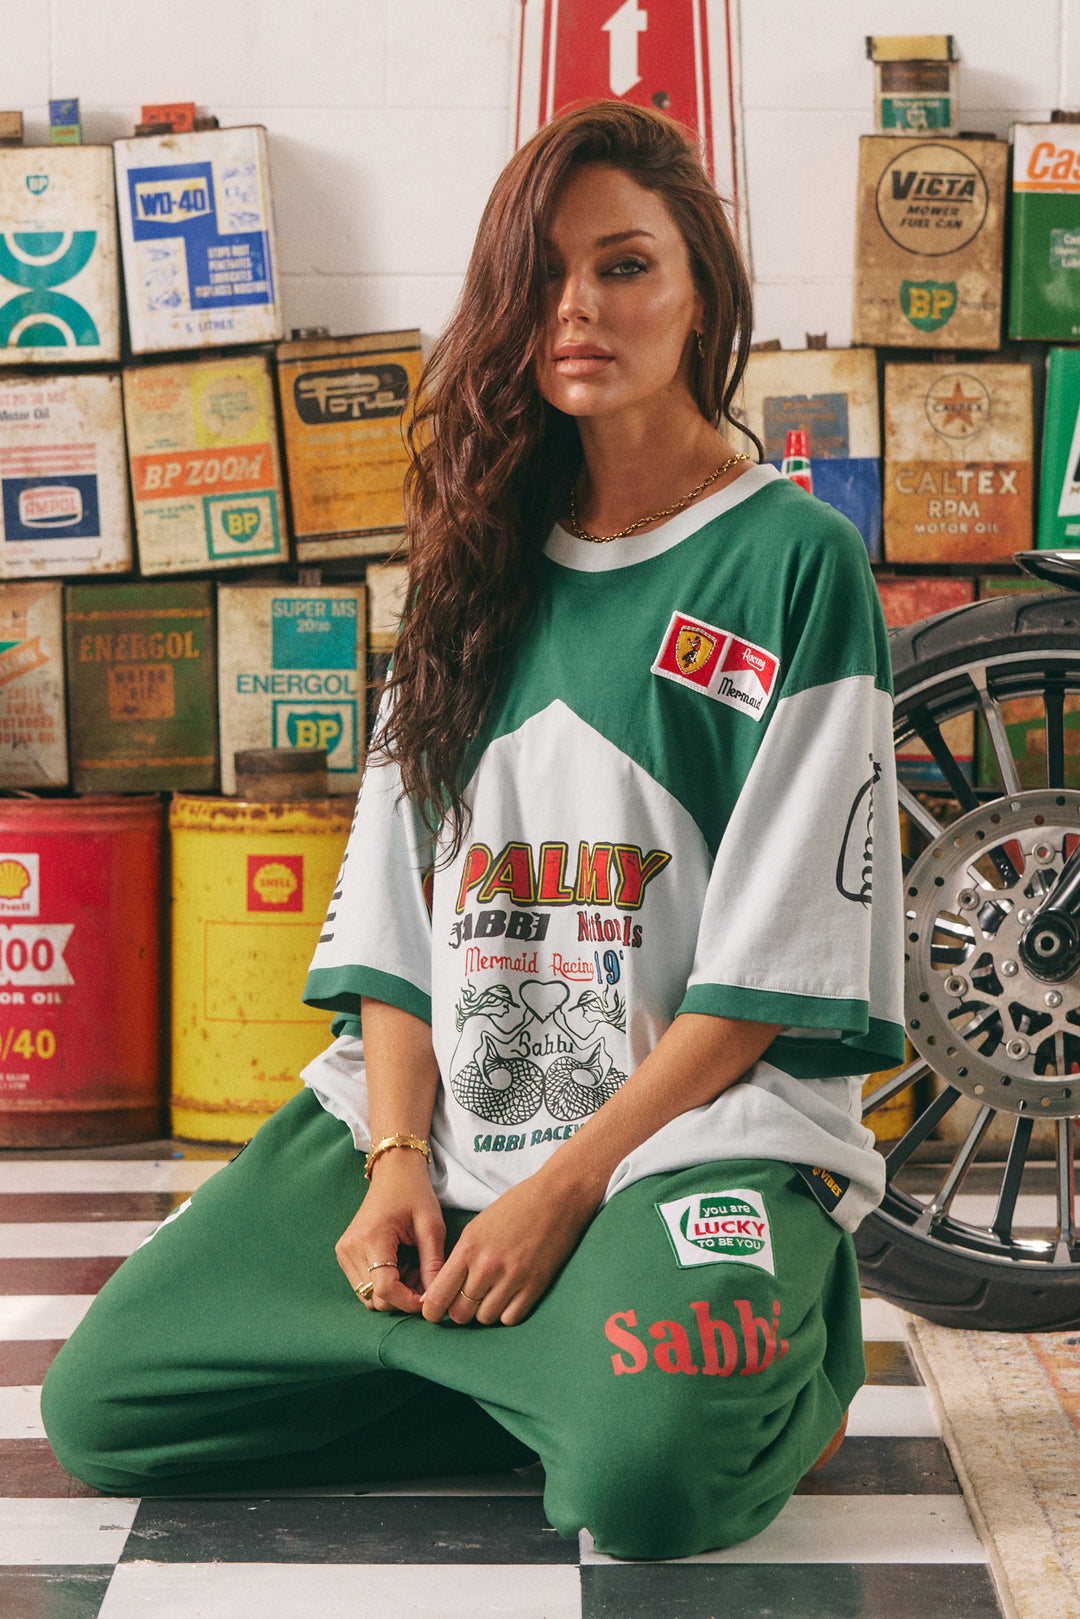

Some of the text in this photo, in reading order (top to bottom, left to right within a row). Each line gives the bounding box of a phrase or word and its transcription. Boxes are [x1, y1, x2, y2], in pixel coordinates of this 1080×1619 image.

[892, 170, 975, 199] VICTA
[140, 188, 206, 216] WD-40
[907, 205, 959, 216] MOWER
[935, 218, 963, 229] CAN
[908, 287, 954, 320] BP
[144, 454, 265, 490] BP ZOOM
[895, 469, 1019, 496] CALTEX
[929, 500, 980, 519] RPM
[227, 512, 258, 536] BP
[913, 522, 1000, 535] MOTOR OIL
[272, 601, 327, 618] SUPER
[79, 631, 200, 662] ENERGOL
[237, 674, 358, 695] ENERGOL
[717, 677, 763, 711] Mermaid
[295, 720, 340, 749] BP
[455, 840, 672, 915] PALMY
[0, 938, 54, 972] 00
[465, 946, 594, 981] Mermaid Racing
[31, 991, 63, 1005] OIL
[473, 1133, 527, 1153] SABBI
[820, 1168, 843, 1198] VIBES
[702, 1204, 751, 1218] you are
[694, 1220, 765, 1238] LUCKY
[697, 1237, 761, 1250] TO BE YOU
[604, 1300, 789, 1378] Sabbi
